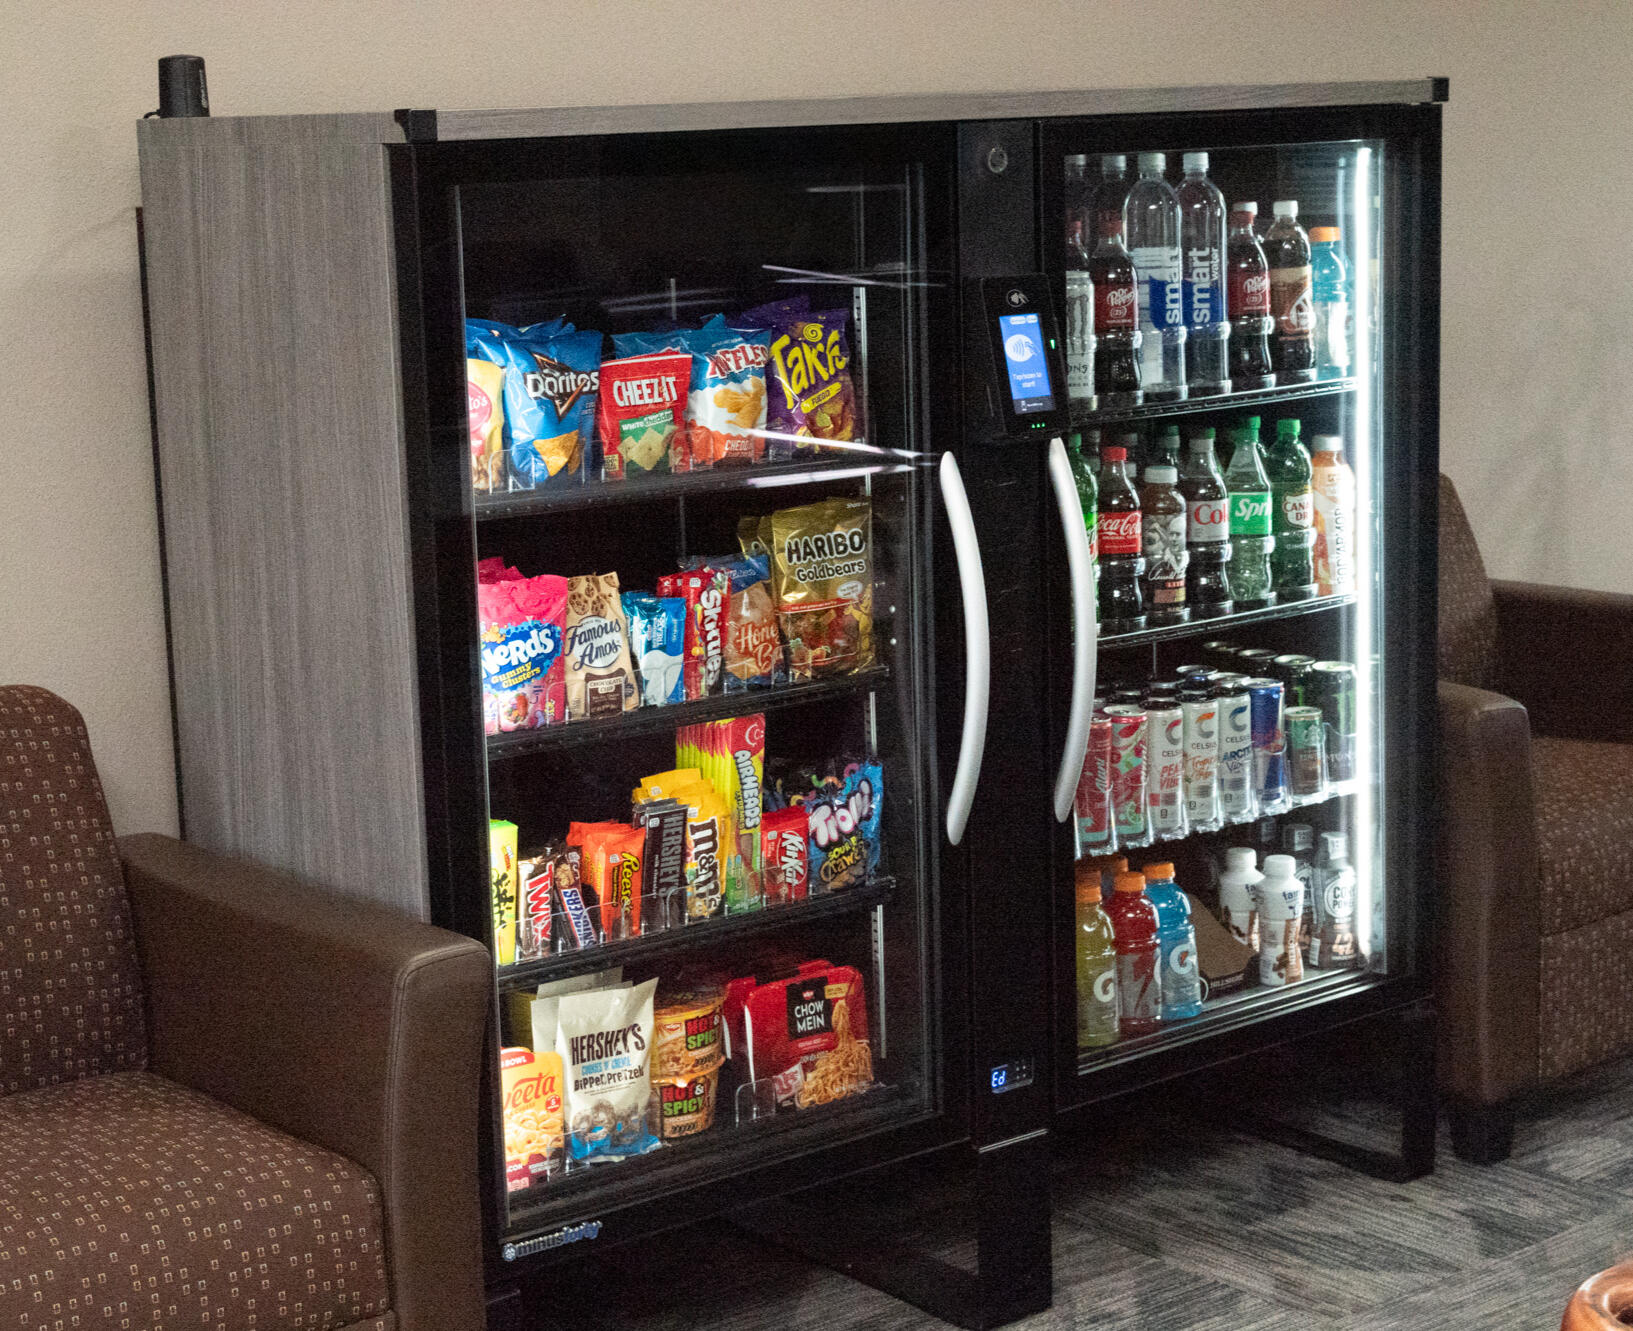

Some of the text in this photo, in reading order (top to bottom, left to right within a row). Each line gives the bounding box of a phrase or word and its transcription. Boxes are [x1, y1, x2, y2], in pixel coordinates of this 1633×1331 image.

[1189, 246, 1219, 324] smart water
[526, 371, 600, 397] Doritos
[785, 528, 865, 565] HARIBO
[796, 560, 866, 582] Goldbears
[565, 618, 622, 656] Famous
[573, 640, 622, 671] Amos
[734, 750, 762, 829] AIRHEADS
[810, 779, 871, 846] Trolli
[659, 812, 684, 897] HERSHEY'S
[621, 851, 640, 914] Reese's
[527, 861, 553, 945] TWIX
[562, 889, 598, 948] SNICKERS
[1169, 943, 1194, 975] G
[1093, 969, 1115, 1002] G
[794, 1001, 824, 1018] CHOW
[797, 1015, 825, 1033] MEIN
[570, 1023, 646, 1066] HERSHEY'S
[694, 1084, 704, 1095] &
